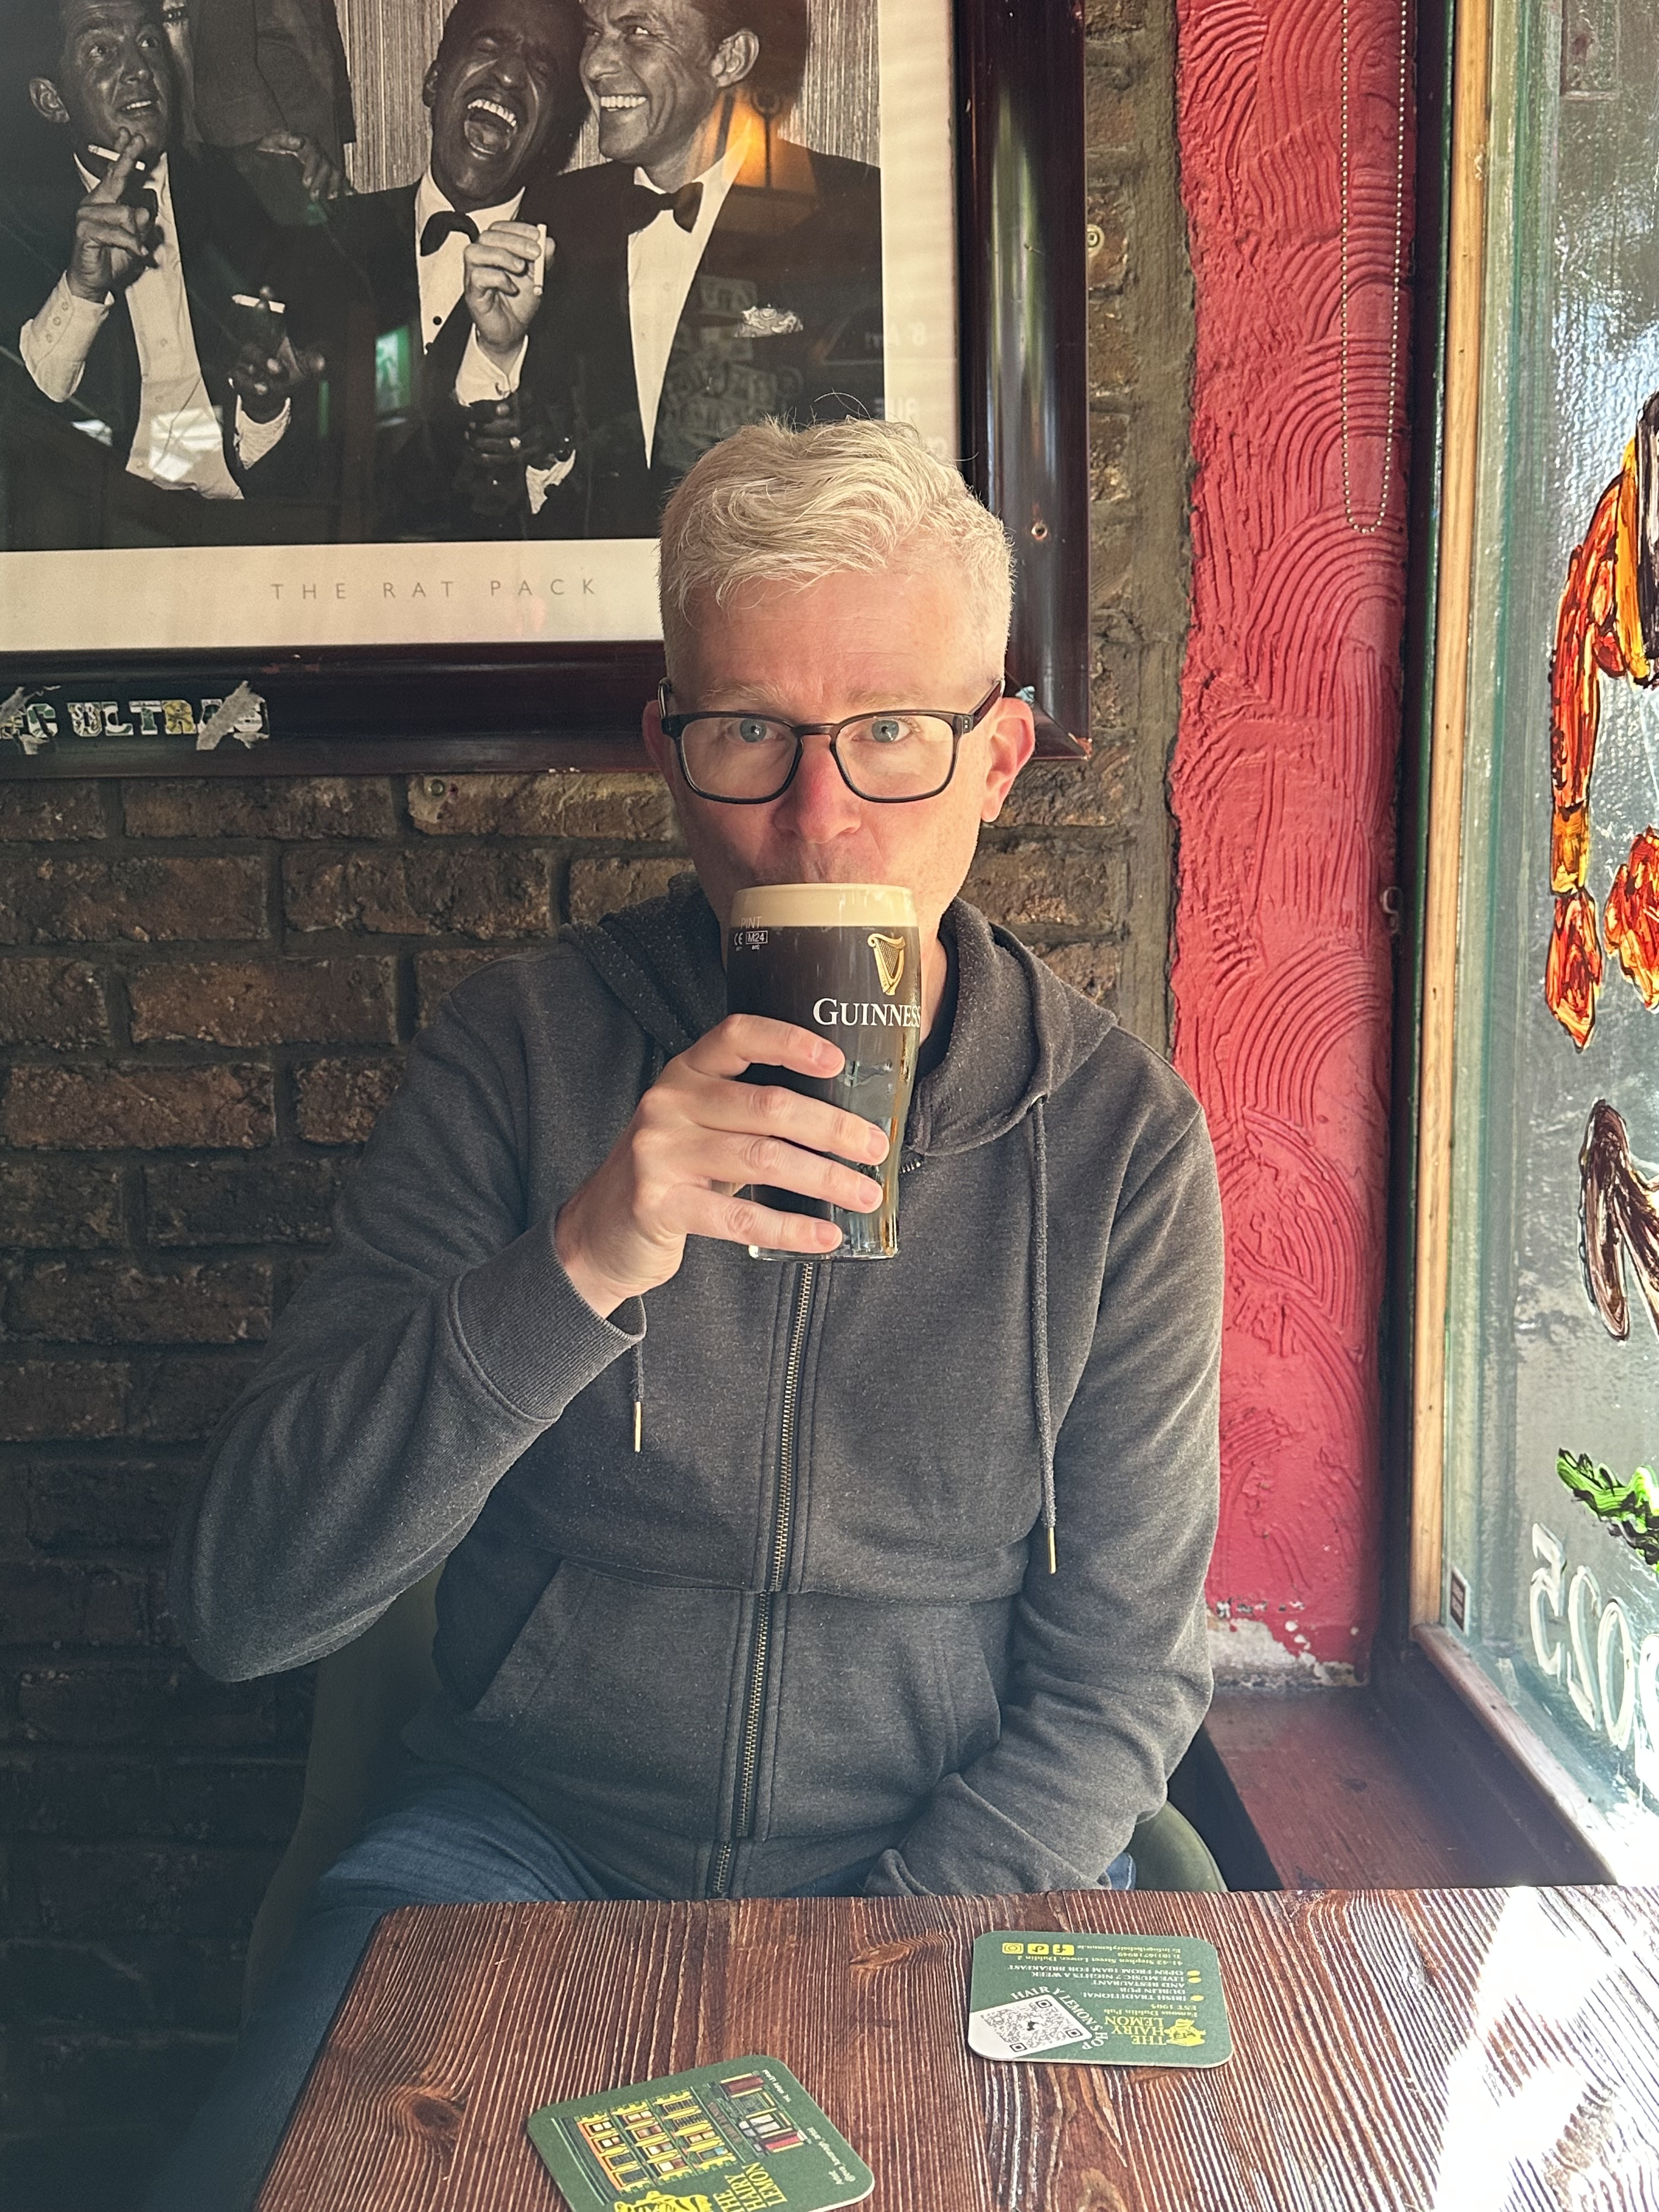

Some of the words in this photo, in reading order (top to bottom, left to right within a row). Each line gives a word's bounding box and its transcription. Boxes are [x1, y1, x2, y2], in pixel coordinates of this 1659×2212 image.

[270, 583, 346, 600] THE
[382, 581, 453, 598] RAT
[490, 578, 595, 596] PACK
[740, 916, 763, 929] PINT
[748, 932, 765, 943] M24
[1011, 1986, 1065, 2000] HAIRY
[1058, 1994, 1097, 2025] LEMON
[1104, 2016, 1164, 2027] LEMON
[1111, 2025, 1165, 2036] HAIRY
[1131, 2035, 1167, 2046] THE
[741, 2162, 788, 2208] LEMON
[724, 2172, 768, 2212] HAIRY
